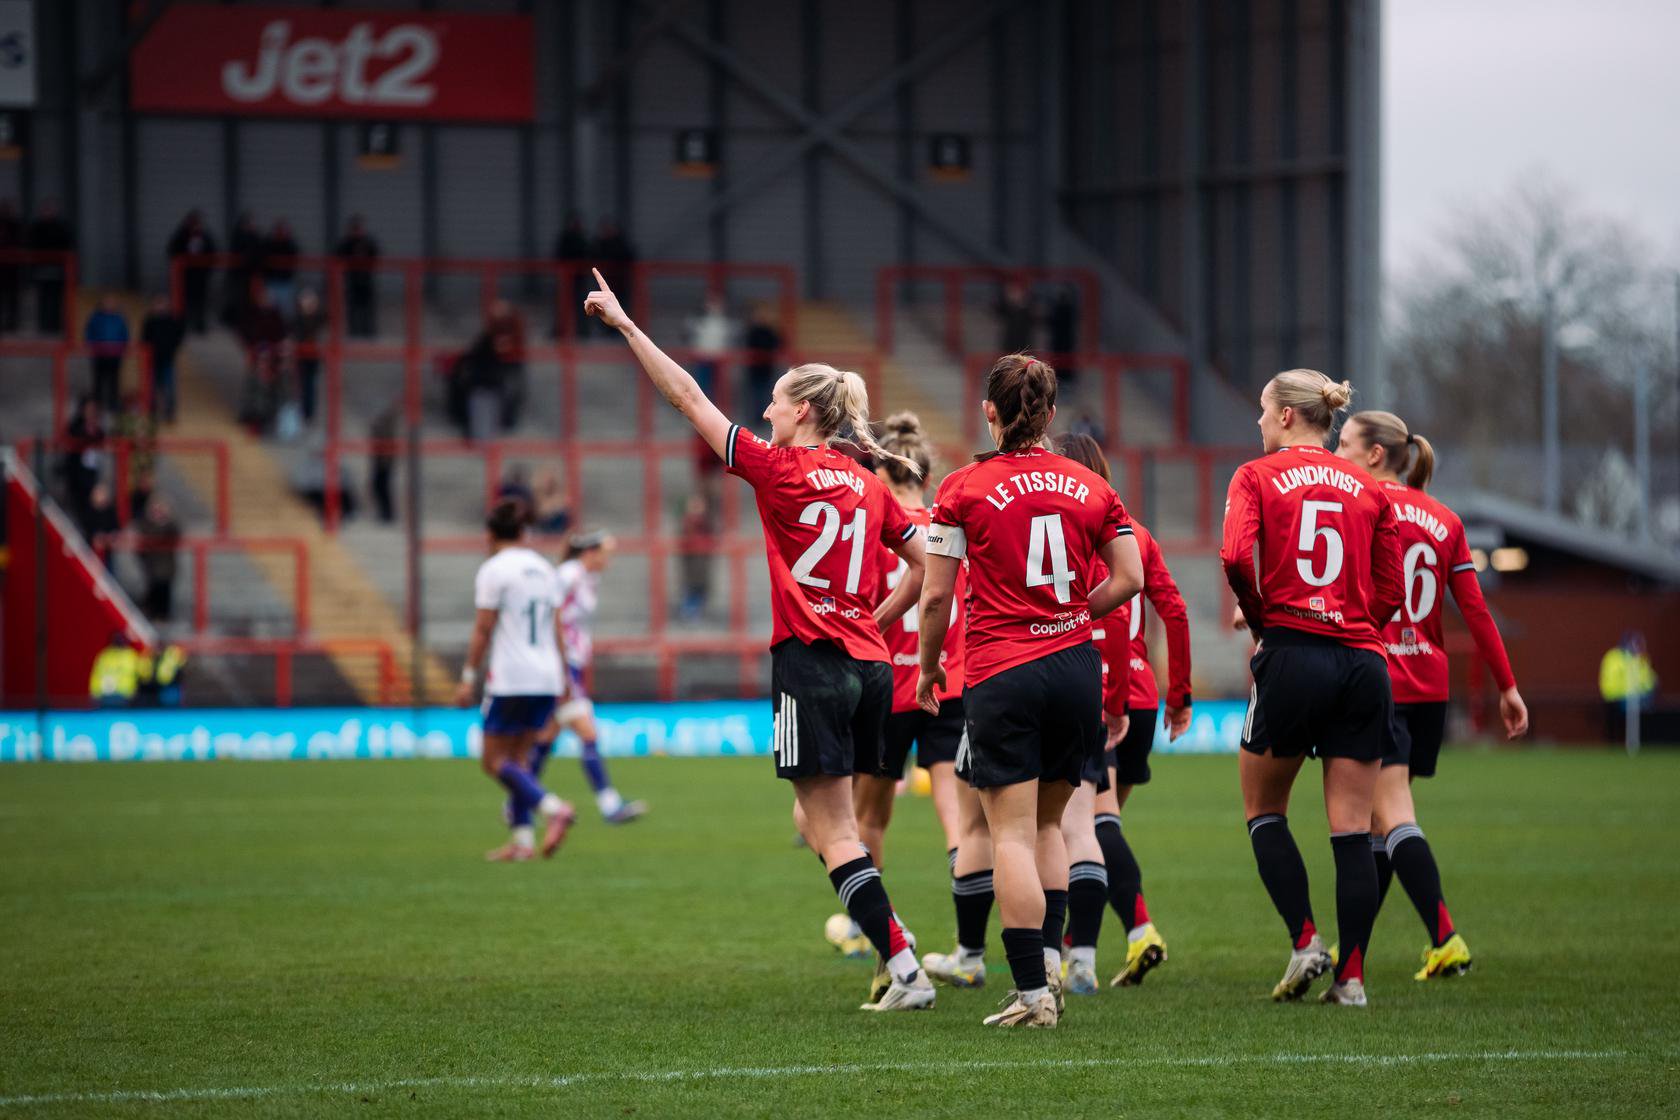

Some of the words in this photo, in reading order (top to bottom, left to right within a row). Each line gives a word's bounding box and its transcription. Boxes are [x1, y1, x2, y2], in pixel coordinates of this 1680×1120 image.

[807, 469, 865, 497] TURNER
[985, 482, 1015, 511] LE
[1010, 471, 1090, 504] TISSIER
[1272, 465, 1364, 498] LUNDKVIST
[1296, 500, 1344, 587] 5
[1393, 502, 1448, 542] LSUND
[790, 501, 867, 594] 21
[1026, 513, 1076, 604] 4
[1391, 542, 1438, 623] 6
[108, 720, 297, 761] Partner
[307, 718, 362, 761] of
[367, 720, 454, 760] the
